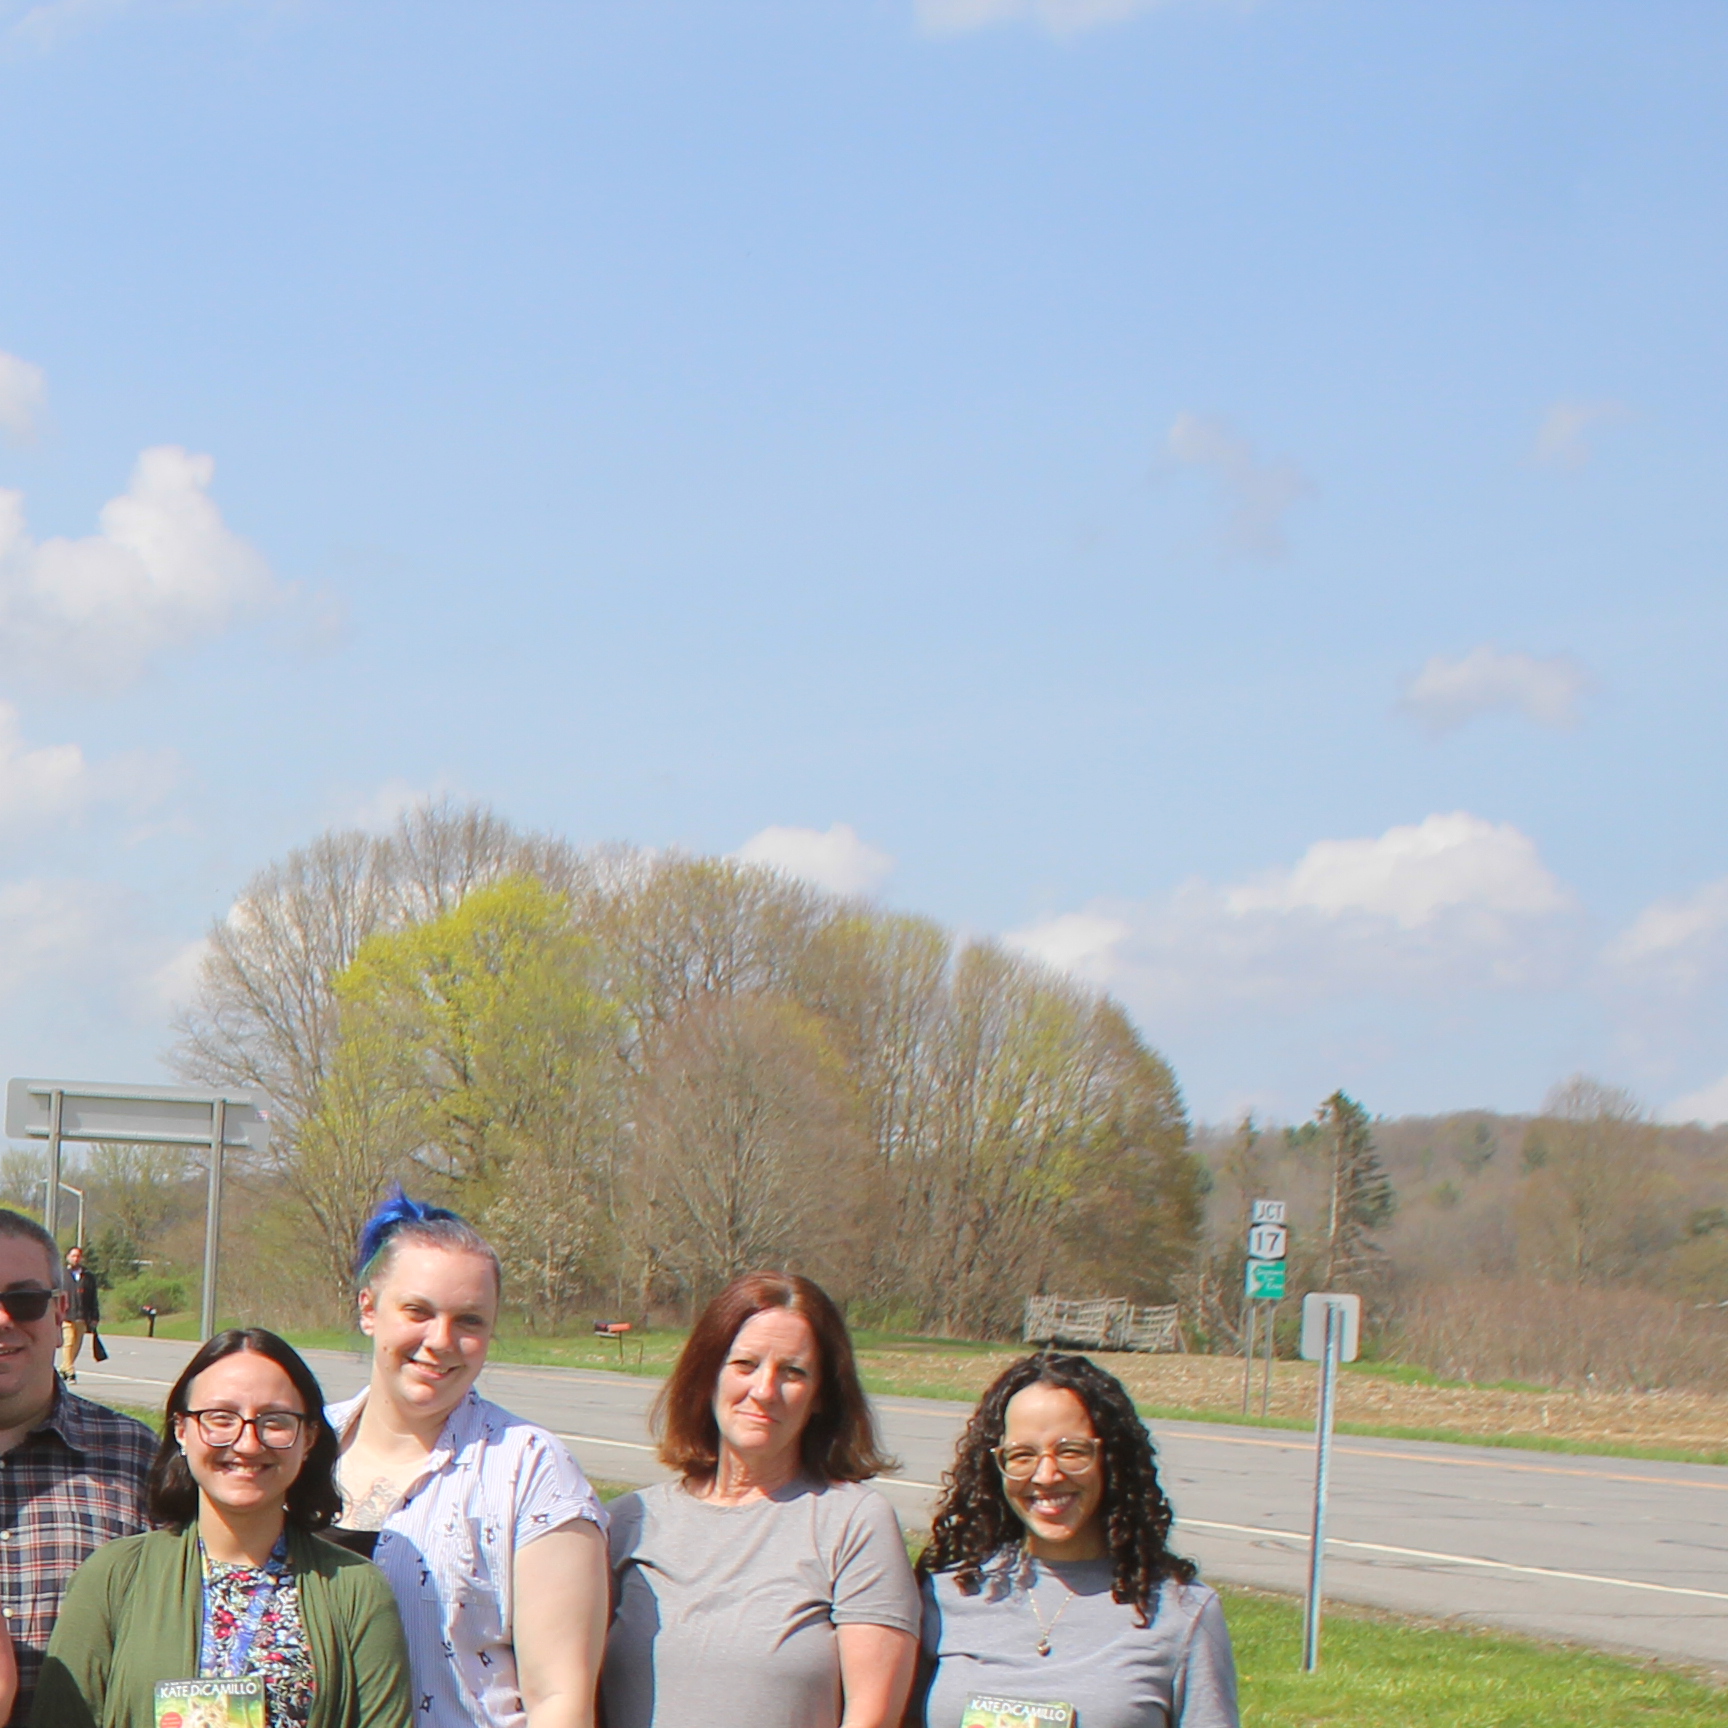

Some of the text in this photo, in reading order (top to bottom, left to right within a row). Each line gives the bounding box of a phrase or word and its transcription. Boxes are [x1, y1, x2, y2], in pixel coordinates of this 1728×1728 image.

[1257, 1203, 1283, 1220] JCT
[1256, 1231, 1281, 1253] 17
[160, 1685, 188, 1698] KATE
[971, 1699, 999, 1713] KATE
